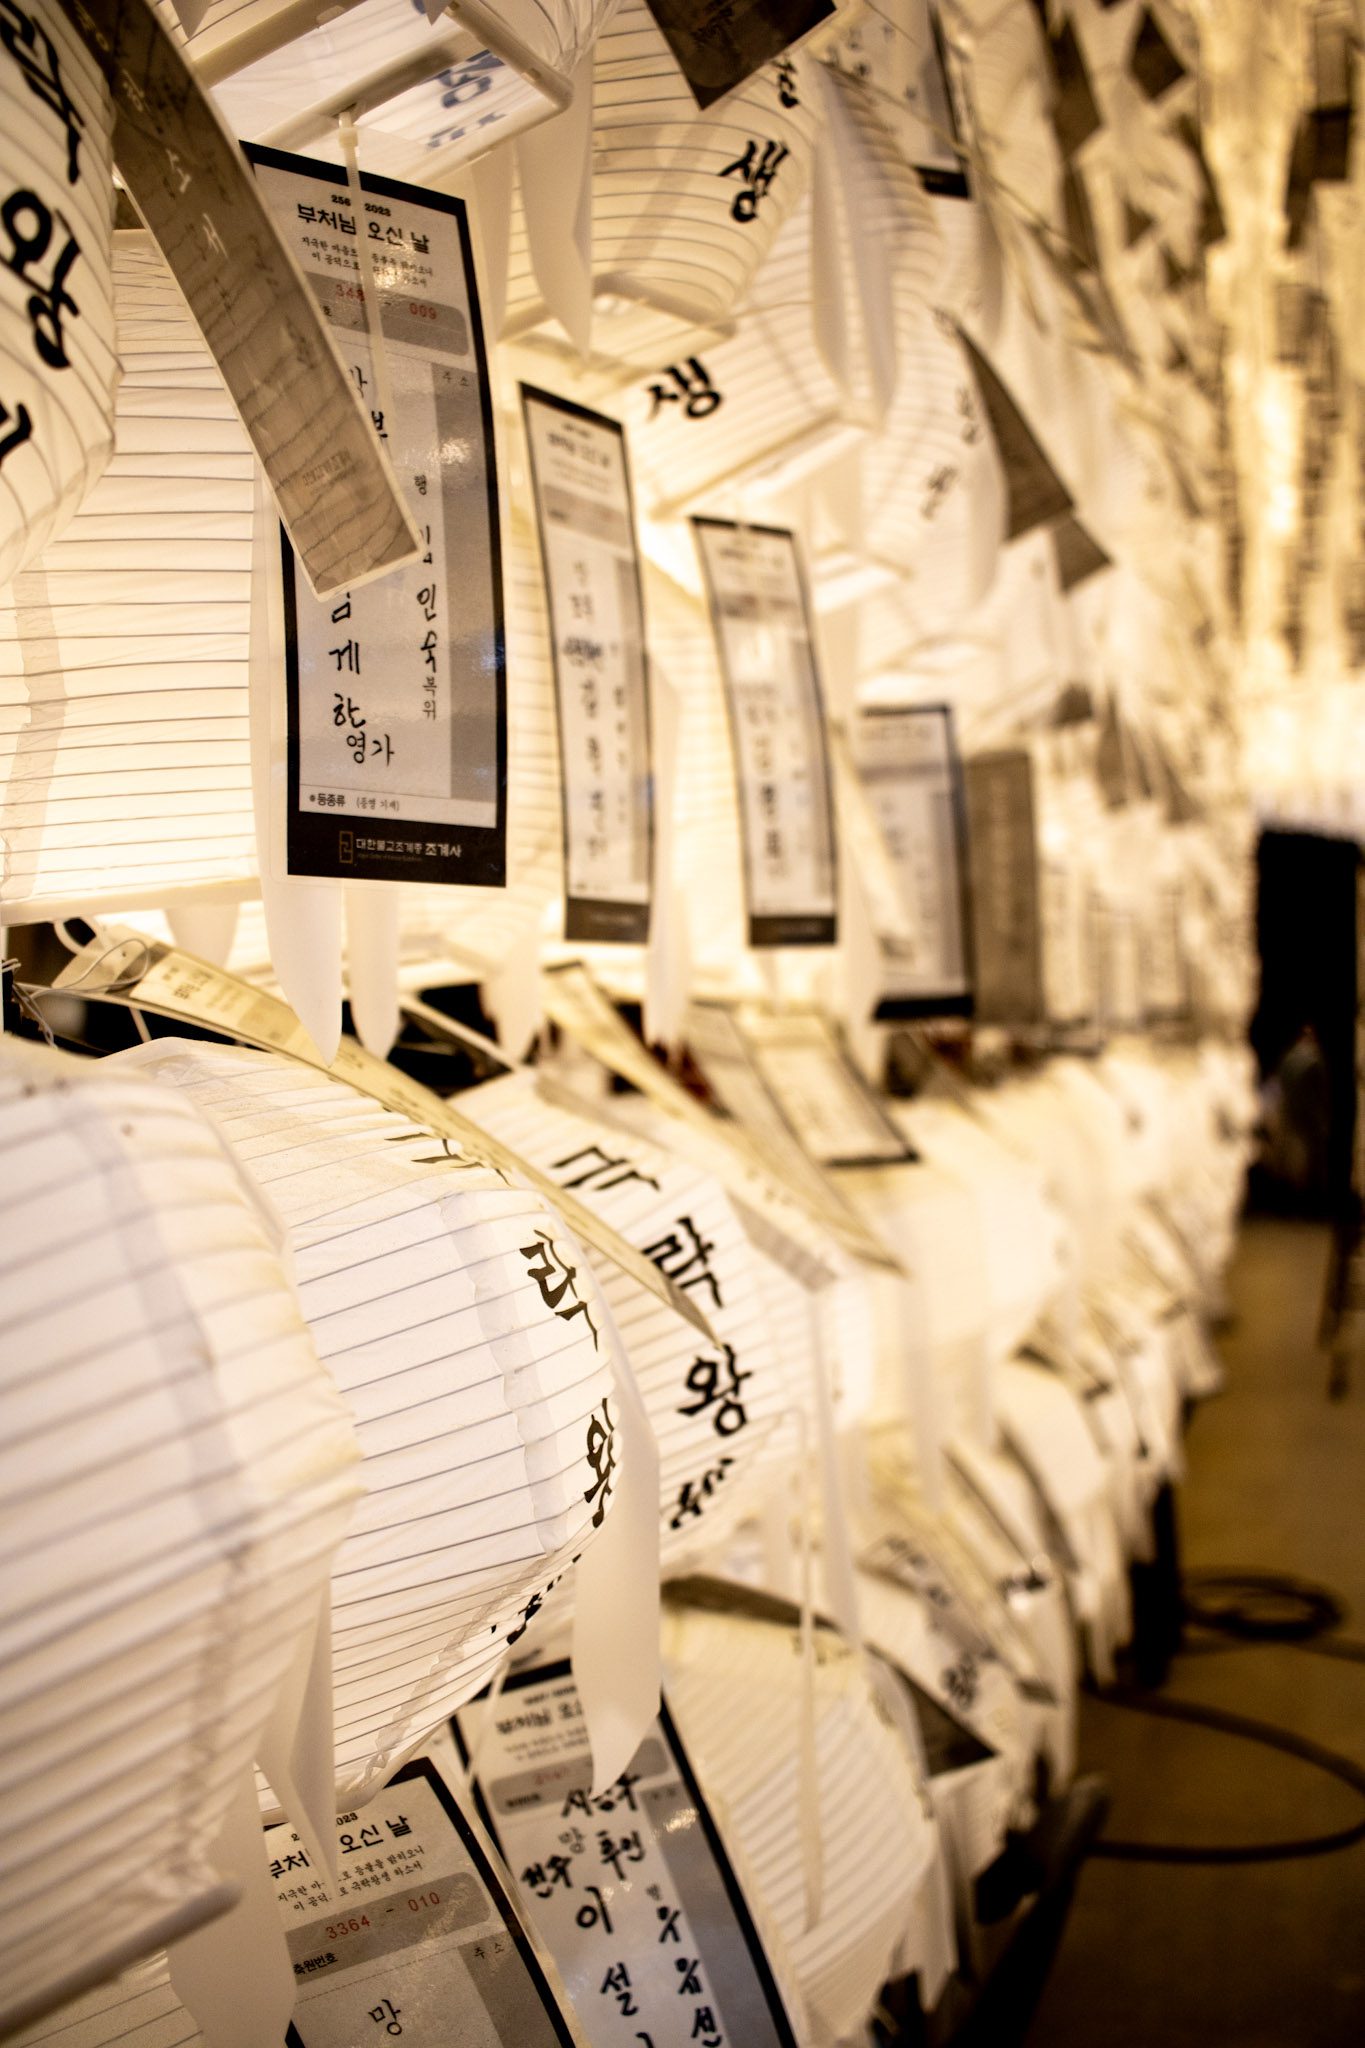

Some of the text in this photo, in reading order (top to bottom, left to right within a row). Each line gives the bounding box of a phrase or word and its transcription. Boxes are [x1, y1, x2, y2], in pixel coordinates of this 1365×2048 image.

[297, 203, 430, 254] 부처님 오신 날
[346, 730, 395, 766] 영가
[316, 792, 346, 808] 등종류
[355, 838, 422, 855] 대한불교조계종
[424, 842, 462, 858] 조계사
[336, 1811, 359, 1827] 023
[269, 1815, 412, 1879] 부처 오신 날
[277, 1885, 308, 1903] 지극한
[325, 1914, 370, 1940] 3364
[407, 1890, 441, 1912] 010
[291, 1950, 339, 1976] 축원번호
[367, 1998, 404, 2037] 망
